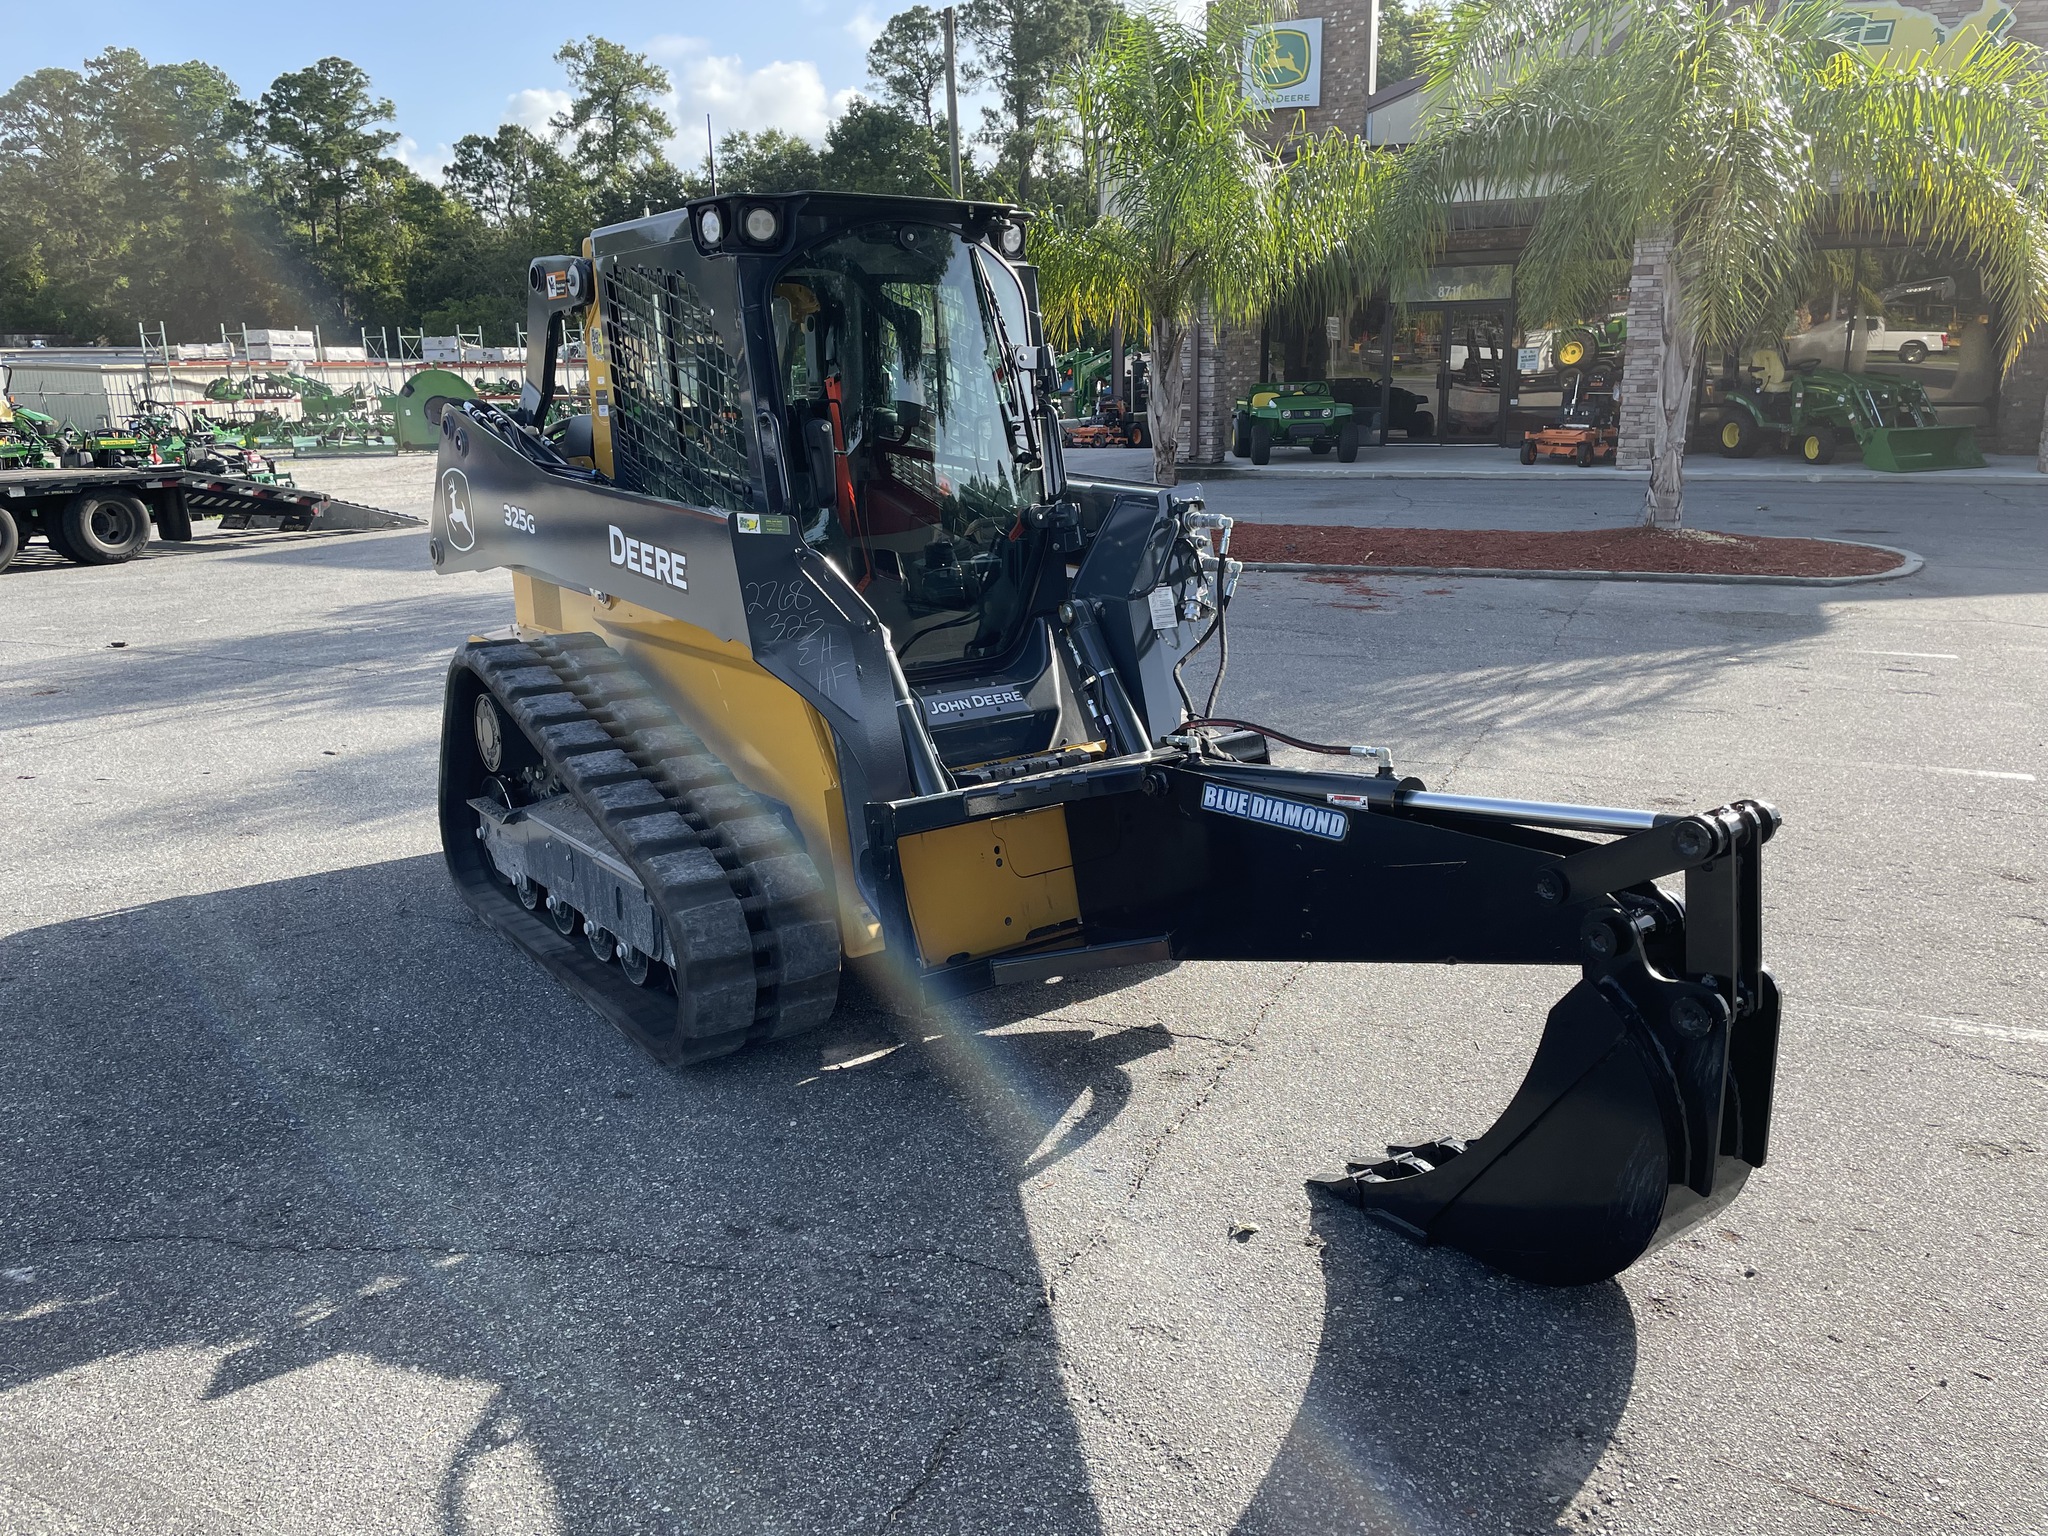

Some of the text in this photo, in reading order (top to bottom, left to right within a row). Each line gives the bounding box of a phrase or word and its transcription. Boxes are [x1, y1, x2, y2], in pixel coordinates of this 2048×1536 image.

[1277, 94, 1310, 103] DEERE
[1438, 285, 1463, 297] 8711
[503, 503, 536, 535] 325G
[608, 524, 688, 590] DEERE
[745, 580, 812, 615] 2768
[764, 609, 825, 642] 325
[931, 691, 1023, 715] JOHN DEERE
[1203, 785, 1346, 837] BLUE DIAMOND
